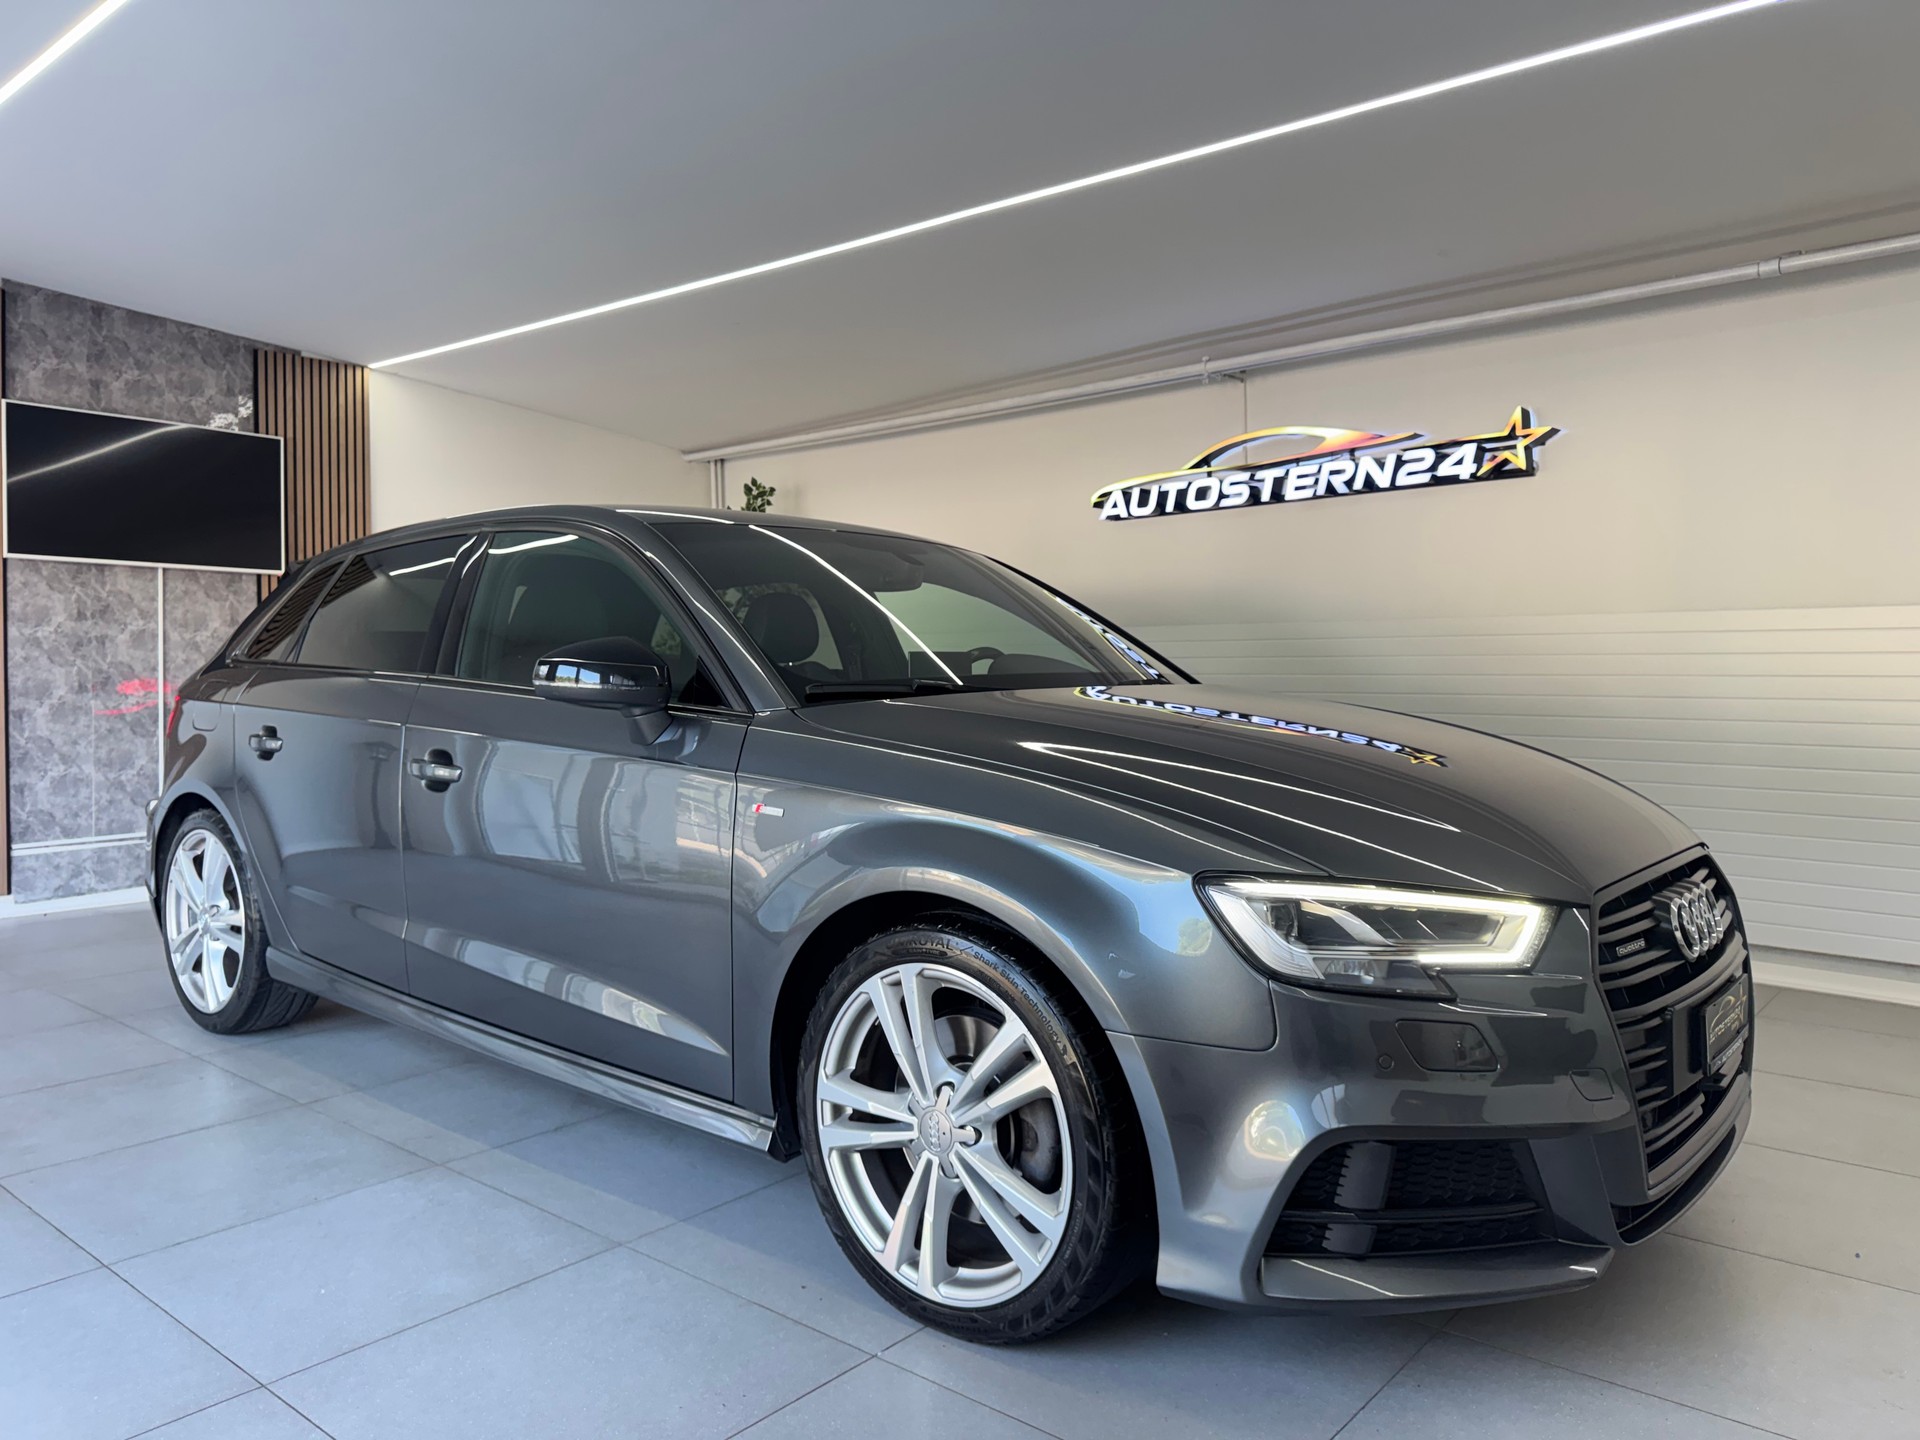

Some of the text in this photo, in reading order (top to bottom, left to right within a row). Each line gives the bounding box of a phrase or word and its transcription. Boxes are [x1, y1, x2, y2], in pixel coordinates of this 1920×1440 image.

[1099, 443, 1478, 520] AUTOSTERN24
[886, 935, 954, 952] IROYAL
[1619, 939, 1645, 955] quattro
[973, 951, 1000, 972] Shark
[1000, 969, 1020, 989] Skin
[1020, 987, 1061, 1046] Technology
